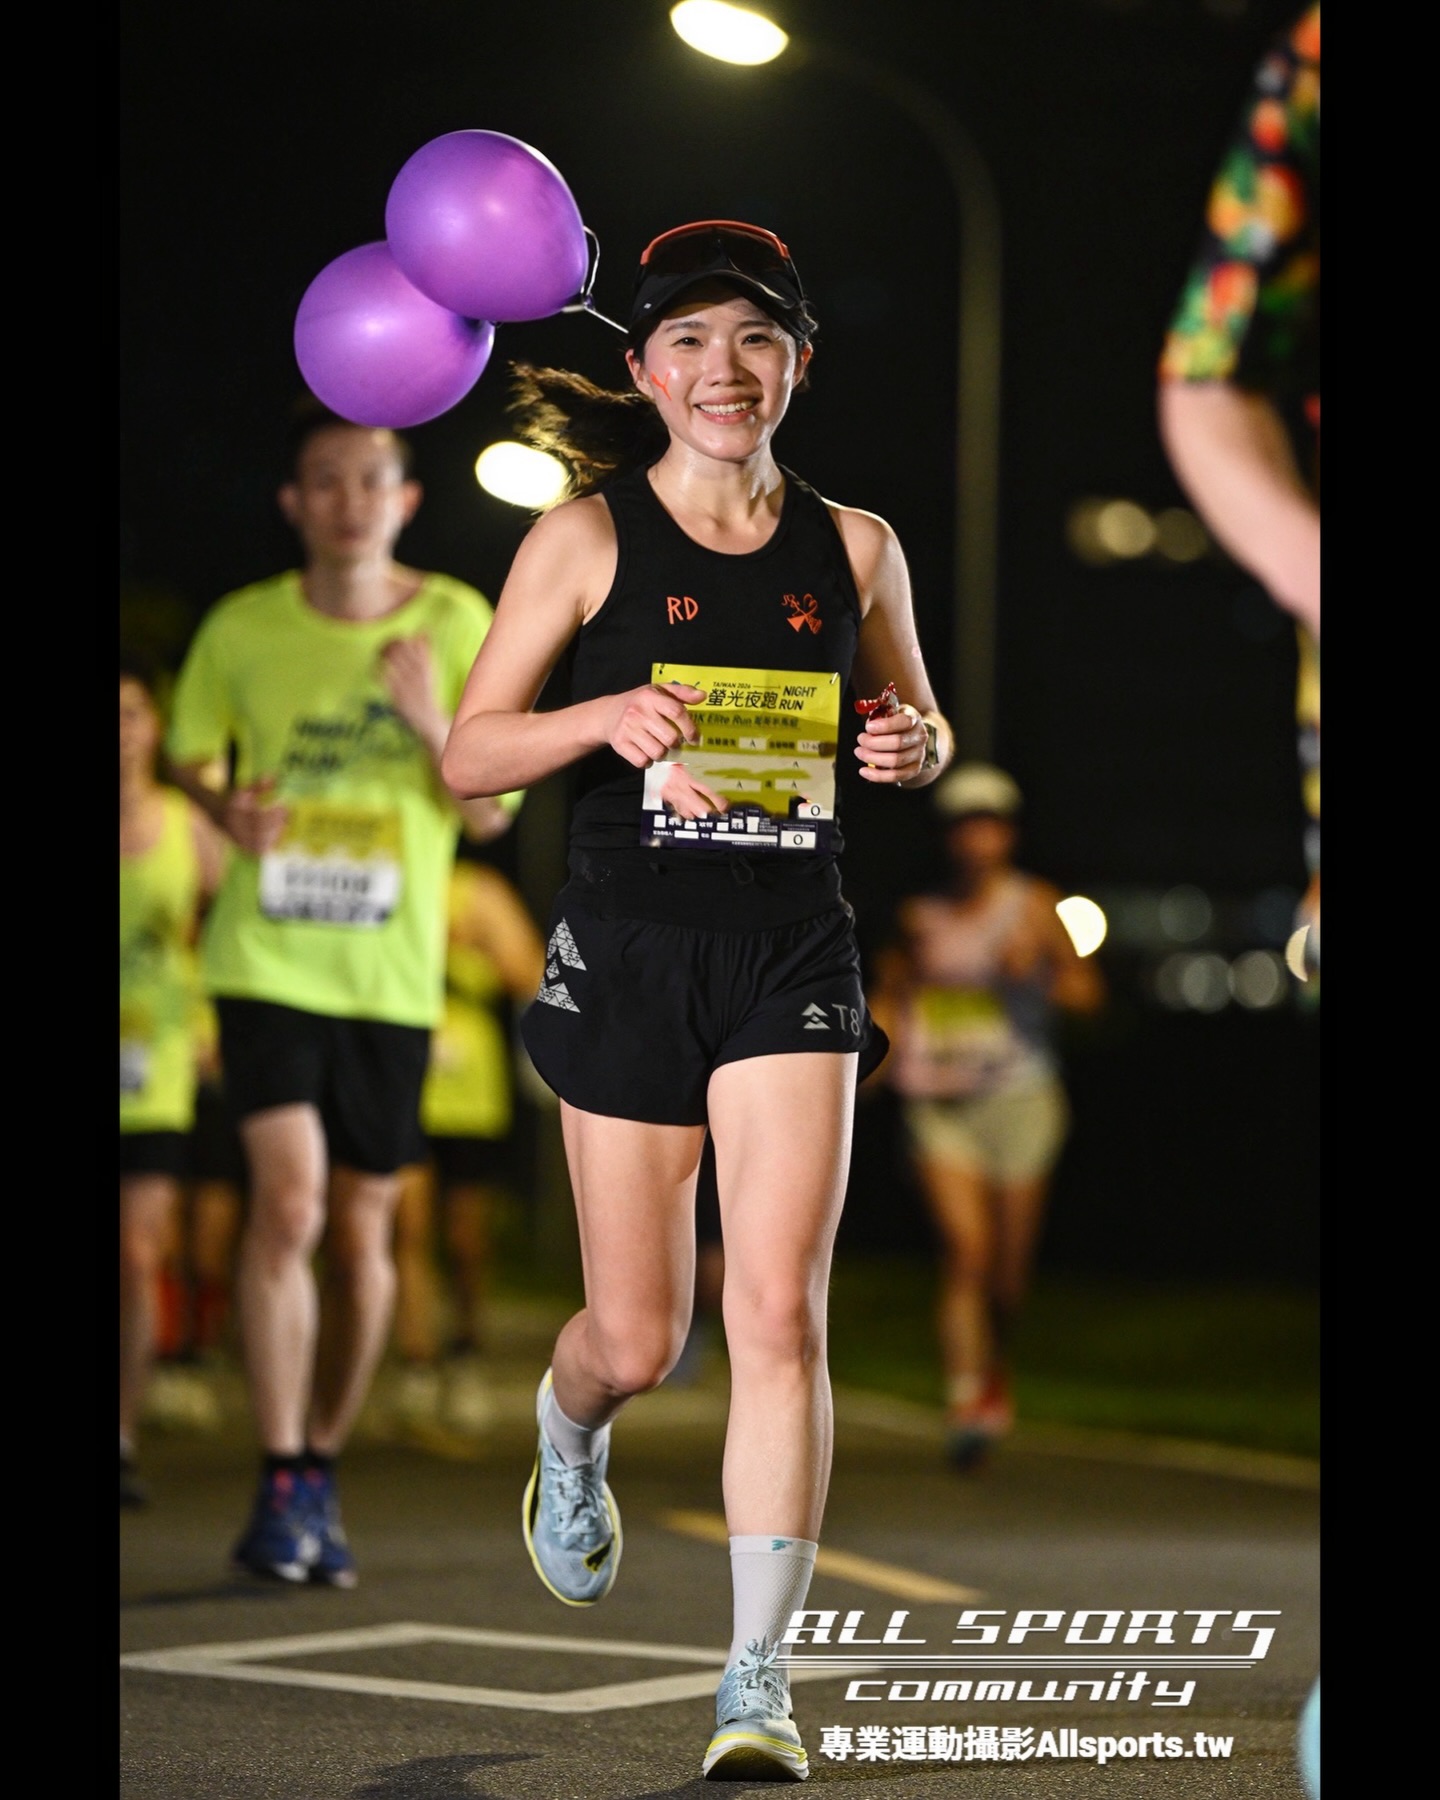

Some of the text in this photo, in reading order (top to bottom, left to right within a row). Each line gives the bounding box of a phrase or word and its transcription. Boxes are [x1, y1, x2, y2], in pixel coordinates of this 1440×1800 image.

[667, 596, 698, 625] RD
[706, 688, 778, 709] 螢光夜跑
[782, 685, 817, 698] NIGHT
[778, 699, 804, 711] RUN
[707, 714, 730, 724] Elite
[732, 715, 752, 726] Run
[831, 1003, 860, 1036] T8
